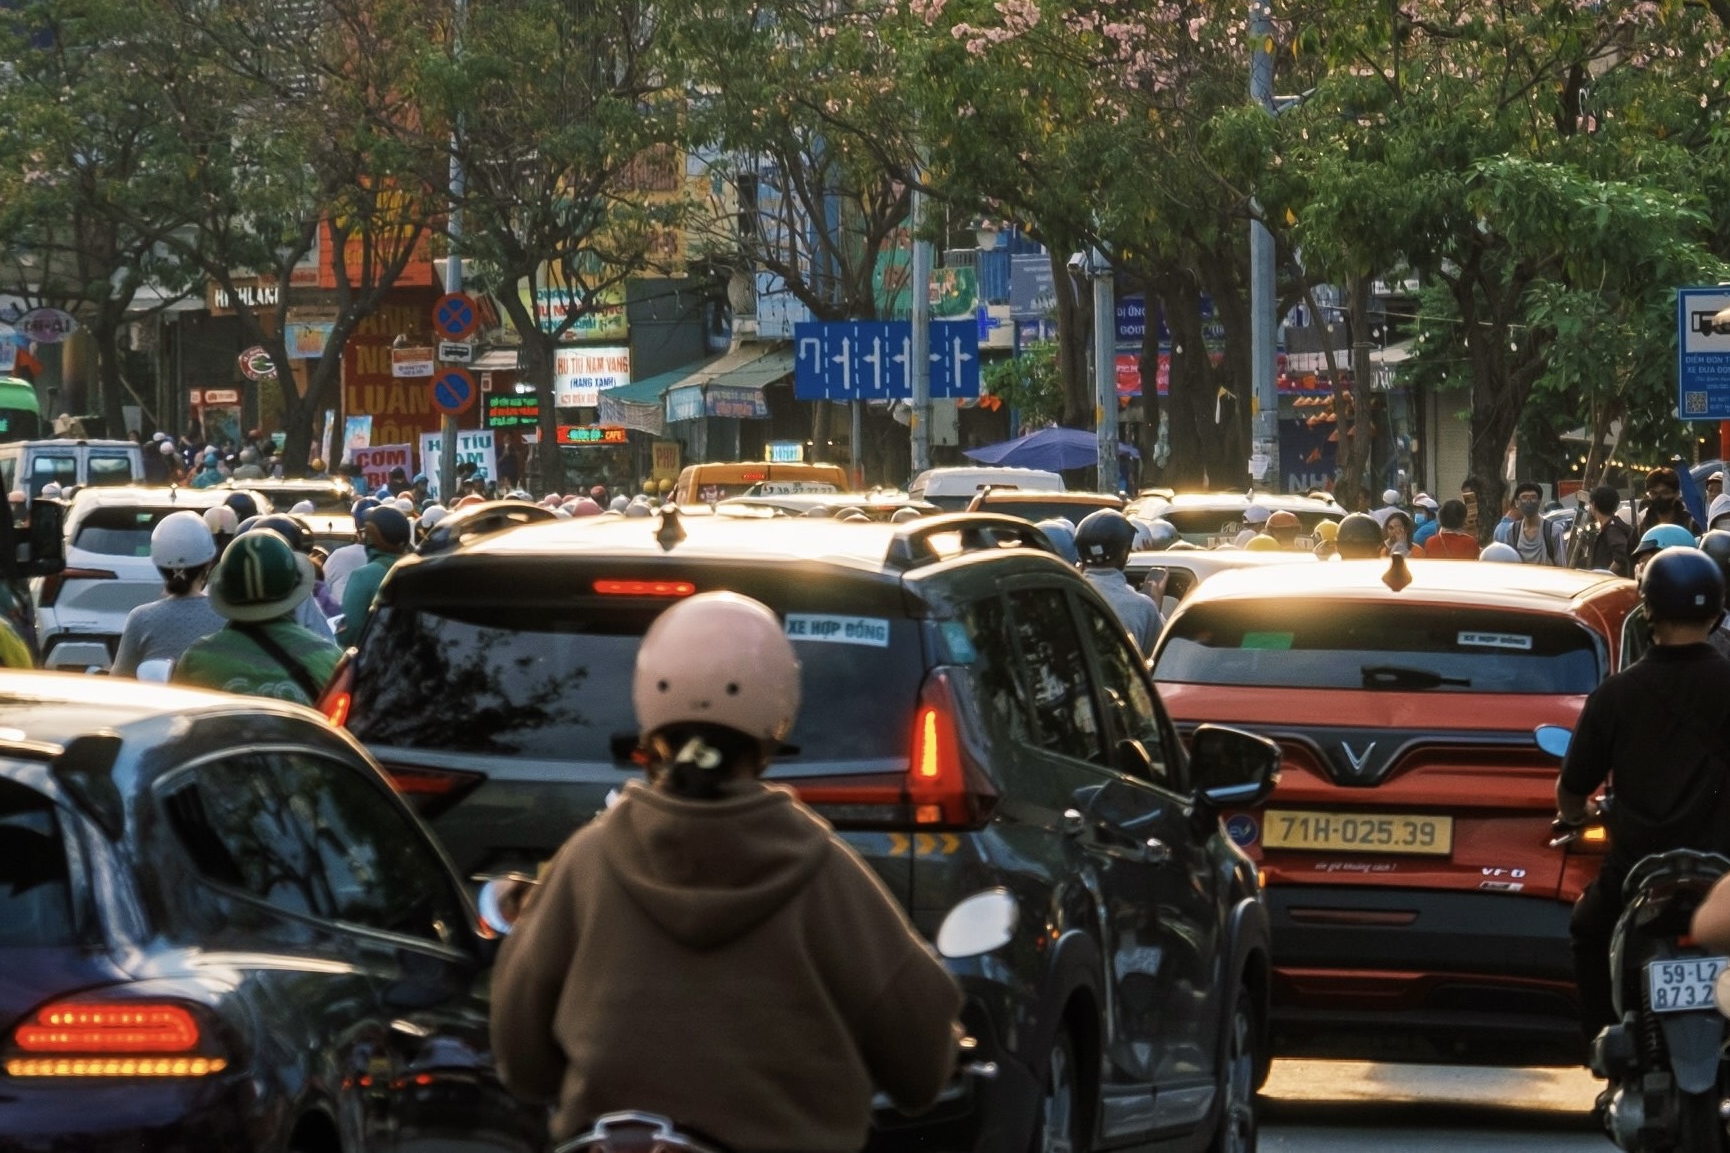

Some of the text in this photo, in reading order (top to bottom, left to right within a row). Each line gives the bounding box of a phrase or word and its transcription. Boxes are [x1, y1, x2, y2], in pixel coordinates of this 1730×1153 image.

[787, 620, 806, 635] XE
[1280, 816, 1436, 847] 71H-025.39
[1656, 984, 1715, 1007] 873.2
